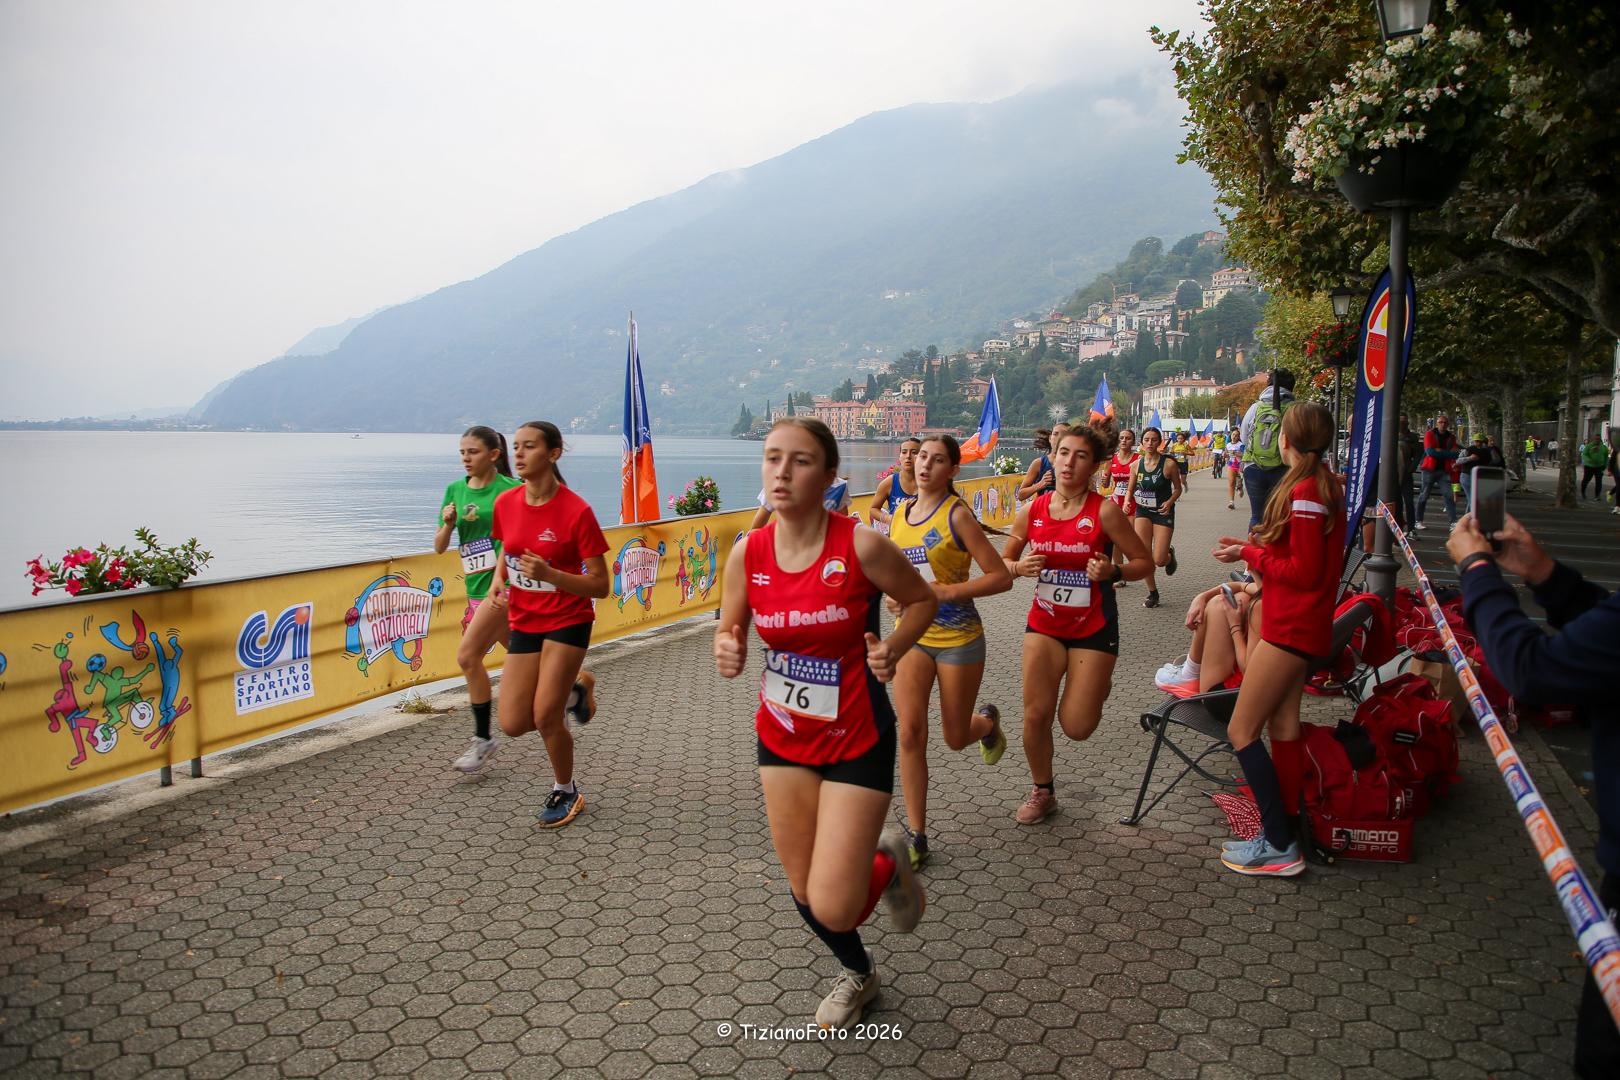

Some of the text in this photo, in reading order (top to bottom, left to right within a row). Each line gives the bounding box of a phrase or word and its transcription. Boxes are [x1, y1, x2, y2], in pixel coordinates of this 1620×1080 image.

[468, 554, 486, 570] 377
[365, 591, 430, 623] CAMPIONATI
[1053, 588, 1073, 603] 67
[788, 604, 849, 627] Barella
[371, 613, 425, 650] NAZIONALI
[236, 663, 309, 687] CENTRO
[791, 658, 838, 669] CENTRO
[791, 664, 838, 676] SPORTIVO
[237, 672, 310, 697] SPORTIVO
[791, 669, 837, 682] ITALIANO
[238, 682, 311, 707] ITALIANO
[784, 681, 810, 709] 76
